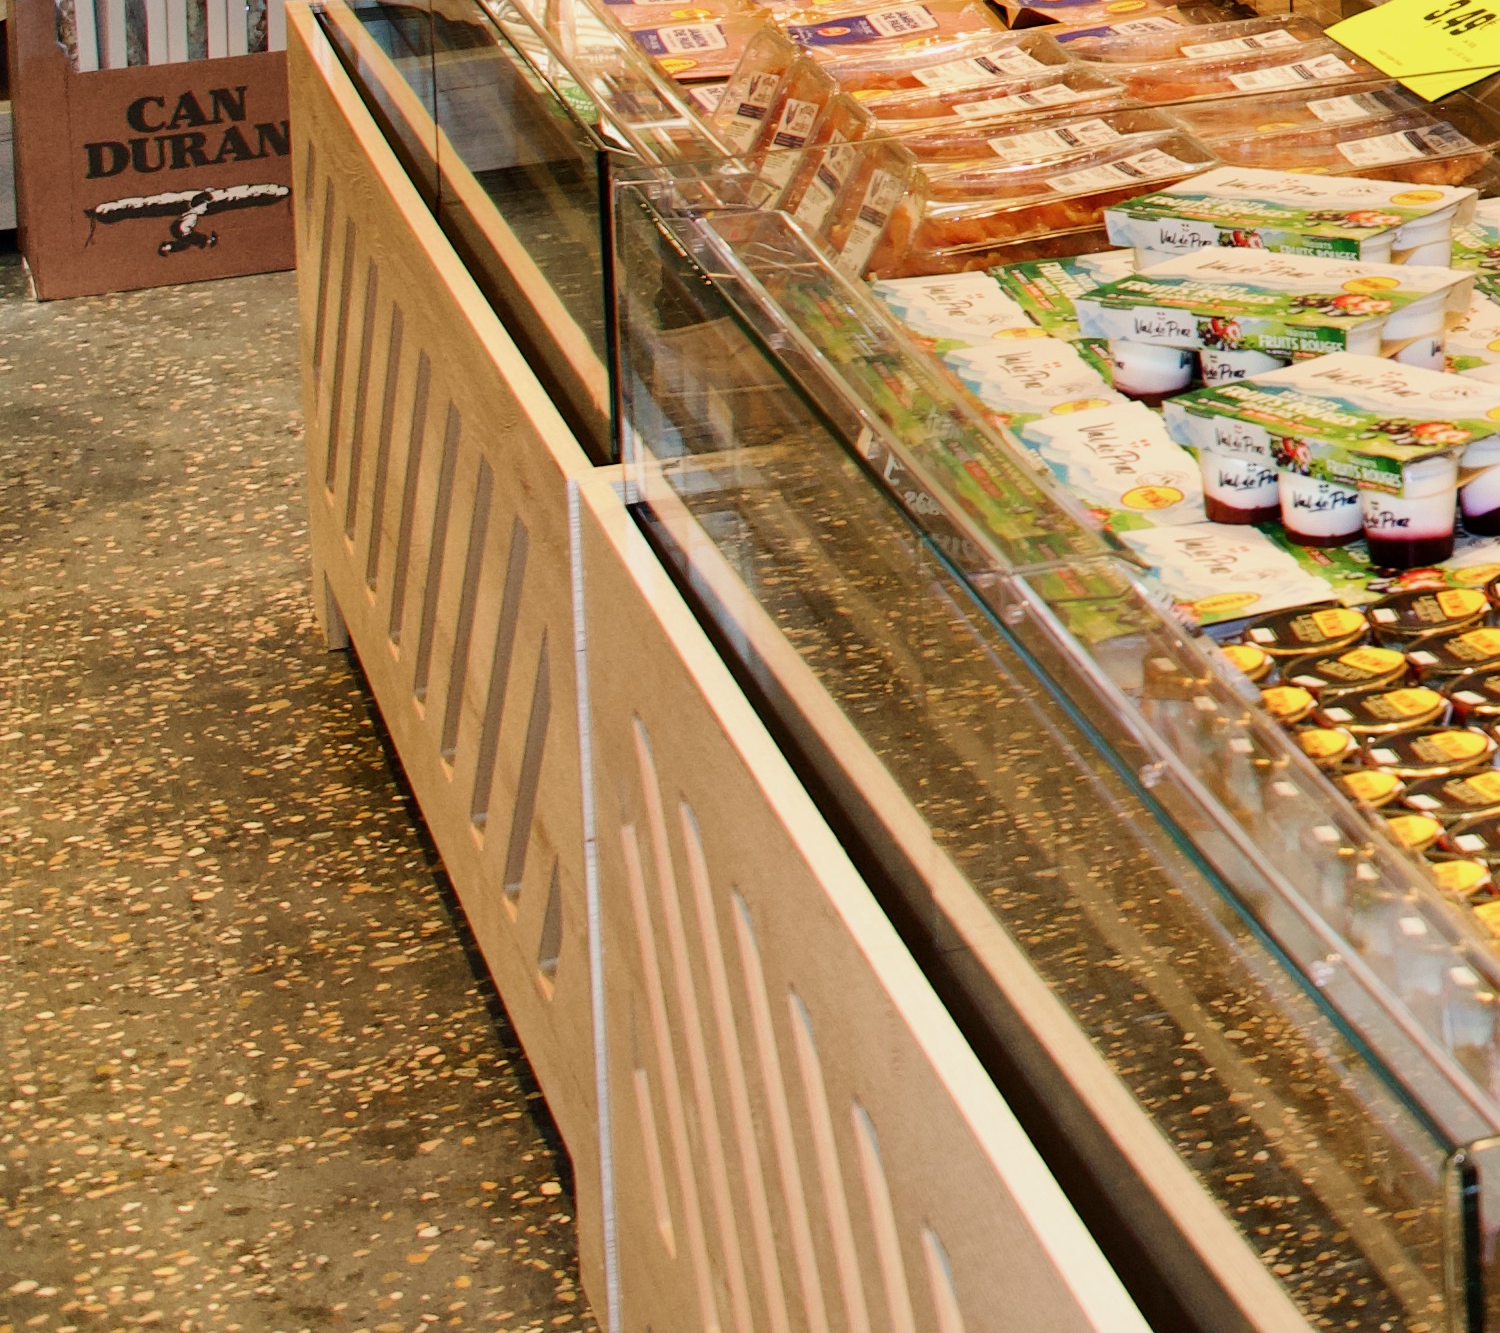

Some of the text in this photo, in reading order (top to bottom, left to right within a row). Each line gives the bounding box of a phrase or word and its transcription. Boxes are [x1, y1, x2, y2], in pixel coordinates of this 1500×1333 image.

[126, 85, 247, 133] CAN
[84, 120, 291, 180] DURAN
[1258, 333, 1345, 352] FRUITS ROUGES
